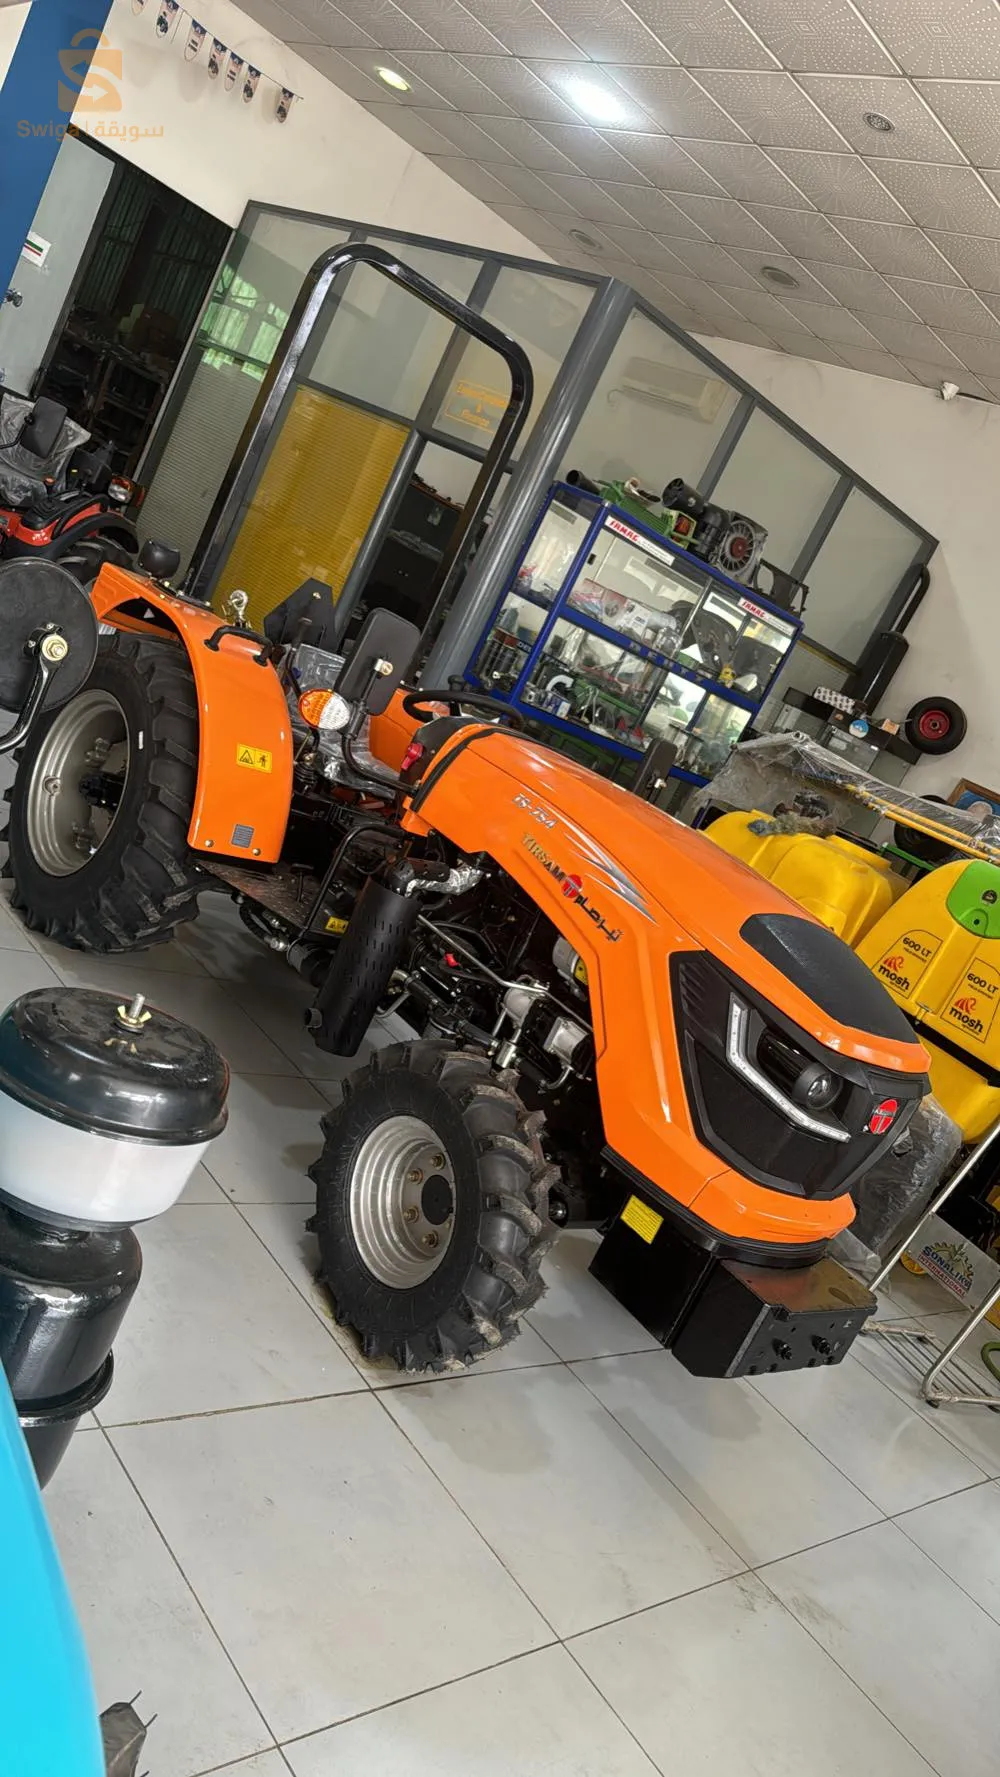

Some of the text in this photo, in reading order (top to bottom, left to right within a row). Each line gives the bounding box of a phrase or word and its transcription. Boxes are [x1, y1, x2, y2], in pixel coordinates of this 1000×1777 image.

[902, 936, 921, 953] 600
[920, 944, 933, 957] LT
[878, 964, 911, 991] mosh
[967, 973, 987, 989] 600
[986, 980, 998, 994] LT
[949, 1007, 984, 1033] mosh
[918, 1253, 966, 1298] INTERNATIONAL
